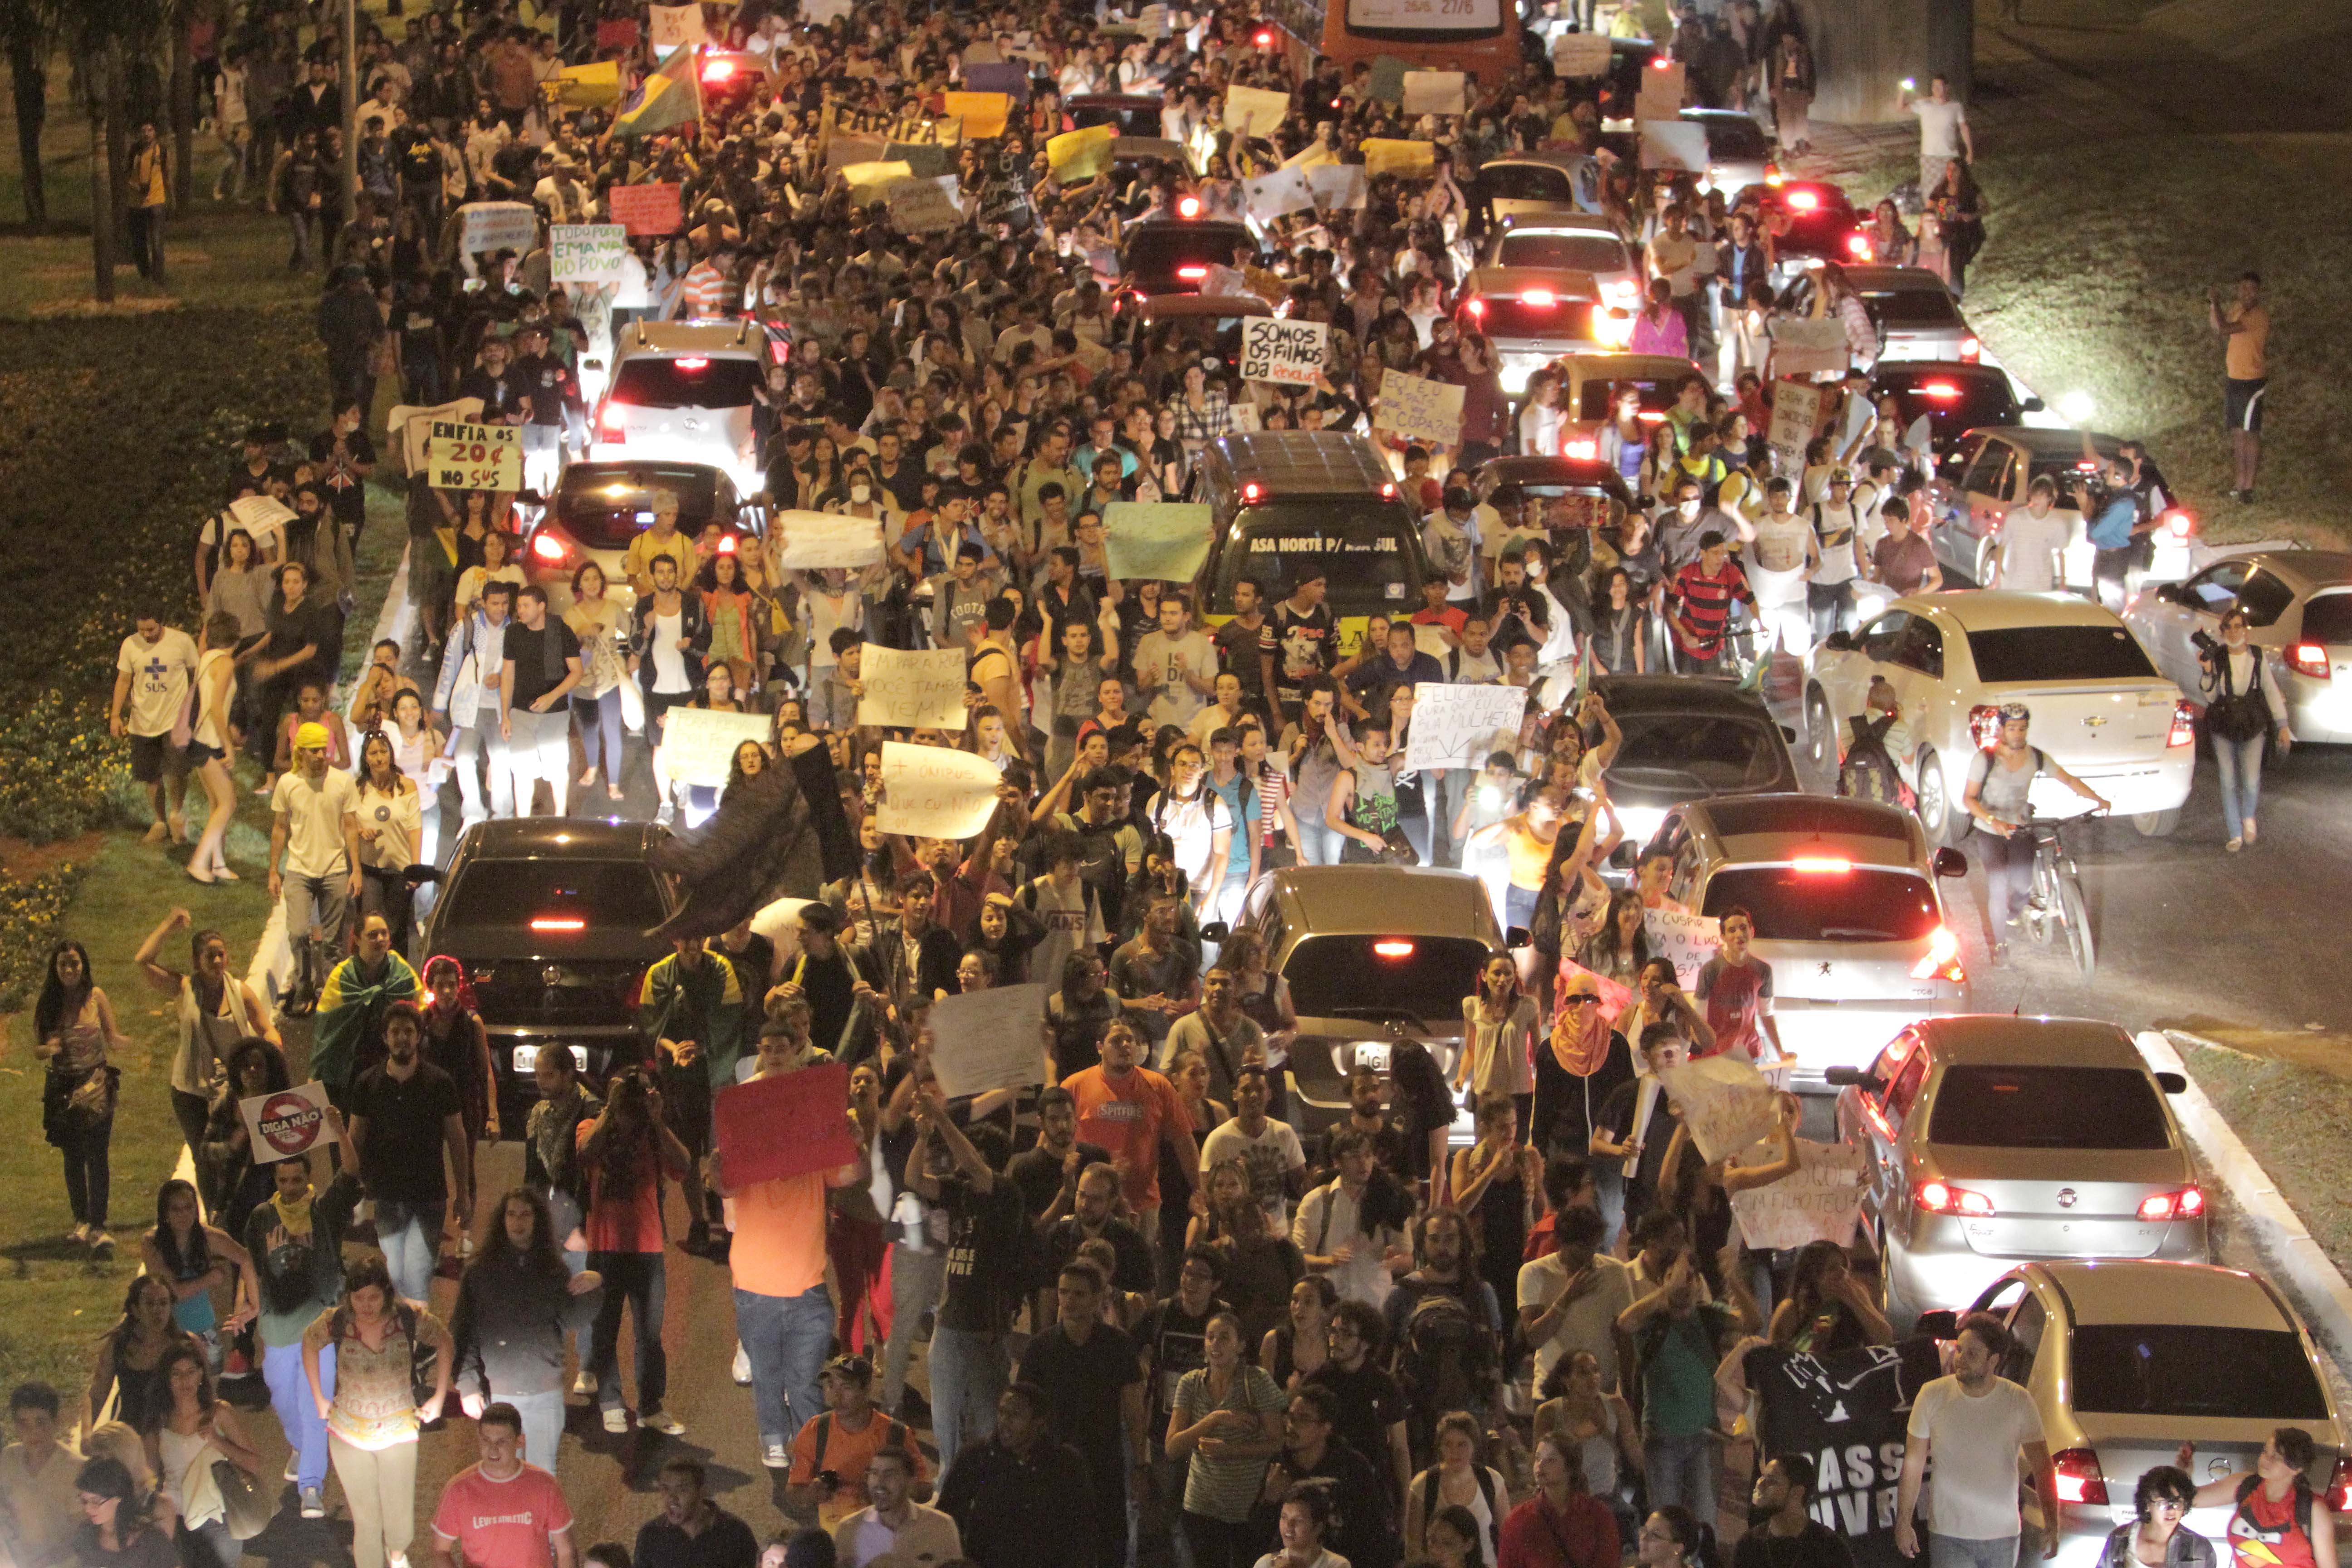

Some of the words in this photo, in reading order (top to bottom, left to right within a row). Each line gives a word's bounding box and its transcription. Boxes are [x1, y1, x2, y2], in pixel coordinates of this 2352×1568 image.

[830, 101, 936, 143] TARIFA
[552, 226, 589, 241] TODO
[592, 226, 624, 238] PODER
[554, 242, 624, 259] EMANA
[554, 261, 575, 277] DO
[579, 257, 620, 274] POVO
[1250, 322, 1316, 344] SOMOS
[1250, 342, 1270, 360] OS
[432, 421, 487, 441] ENFIA
[496, 429, 513, 441] OS
[441, 470, 463, 485] NO
[470, 469, 500, 487] SUS
[1250, 538, 1276, 552] ASA
[1279, 538, 1322, 552] NORTE
[1326, 538, 1343, 553] P/
[145, 682, 167, 693] SUS
[1419, 685, 1497, 703] FELICIANO
[1417, 705, 1445, 717] CURA
[1475, 698, 1492, 710] EU
[925, 799, 941, 811] EU
[1662, 912, 1704, 929] CUSPIR
[1686, 952, 1701, 960] DE
[261, 1119, 290, 1134] DIGA
[291, 1111, 319, 1127] NÃO
[499, 1511, 533, 1525] ATHLETIC
